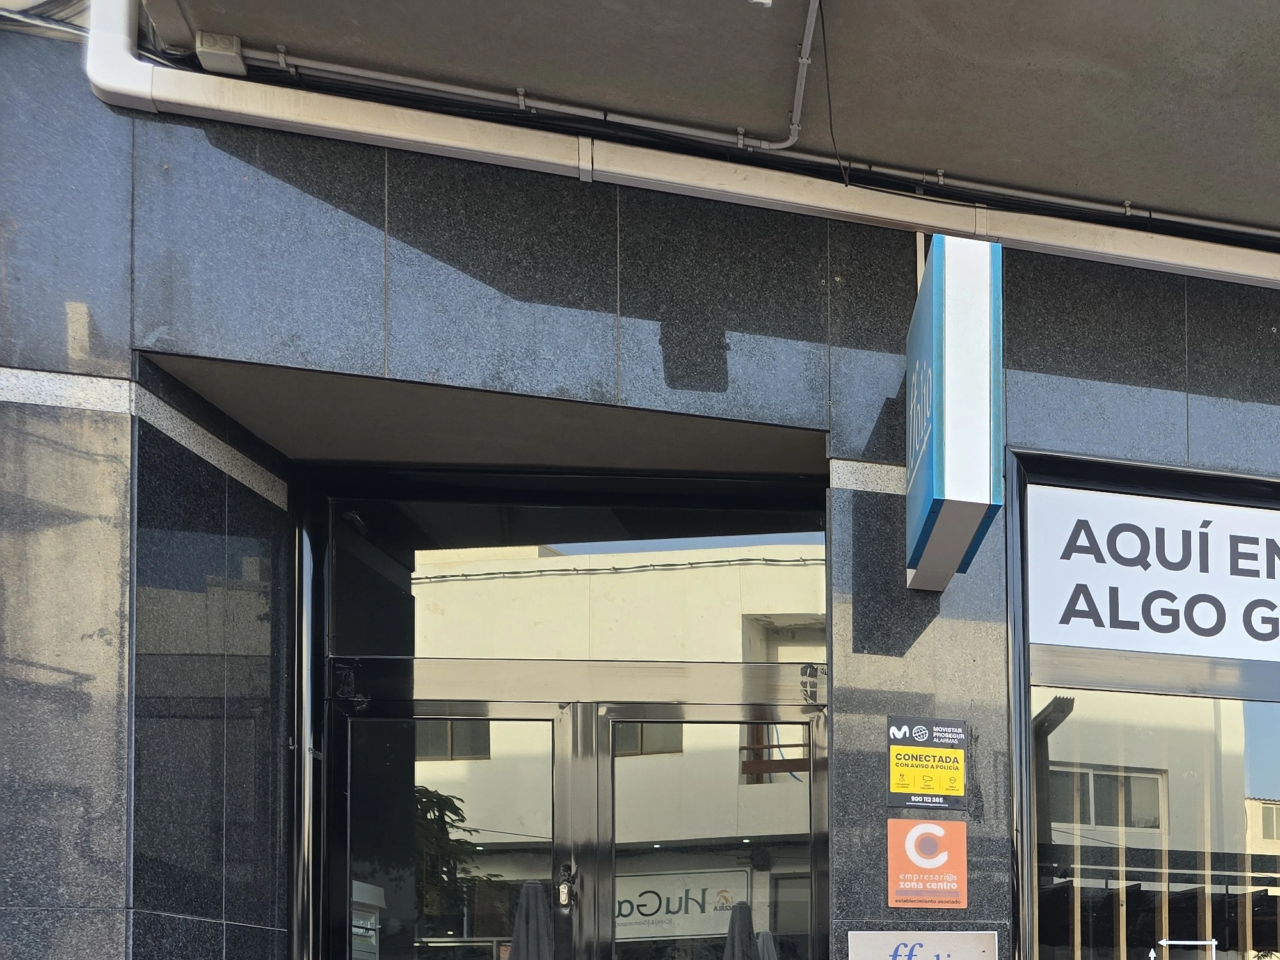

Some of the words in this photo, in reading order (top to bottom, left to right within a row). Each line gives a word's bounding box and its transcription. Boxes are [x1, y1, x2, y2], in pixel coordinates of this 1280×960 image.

[1060, 518, 1213, 574] AQUÍ
[1058, 583, 1226, 637] ALGO
[895, 753, 959, 764] CONECTADA
[899, 873, 958, 882] empresari@s
[899, 881, 923, 889] zona
[926, 881, 958, 890] centro
